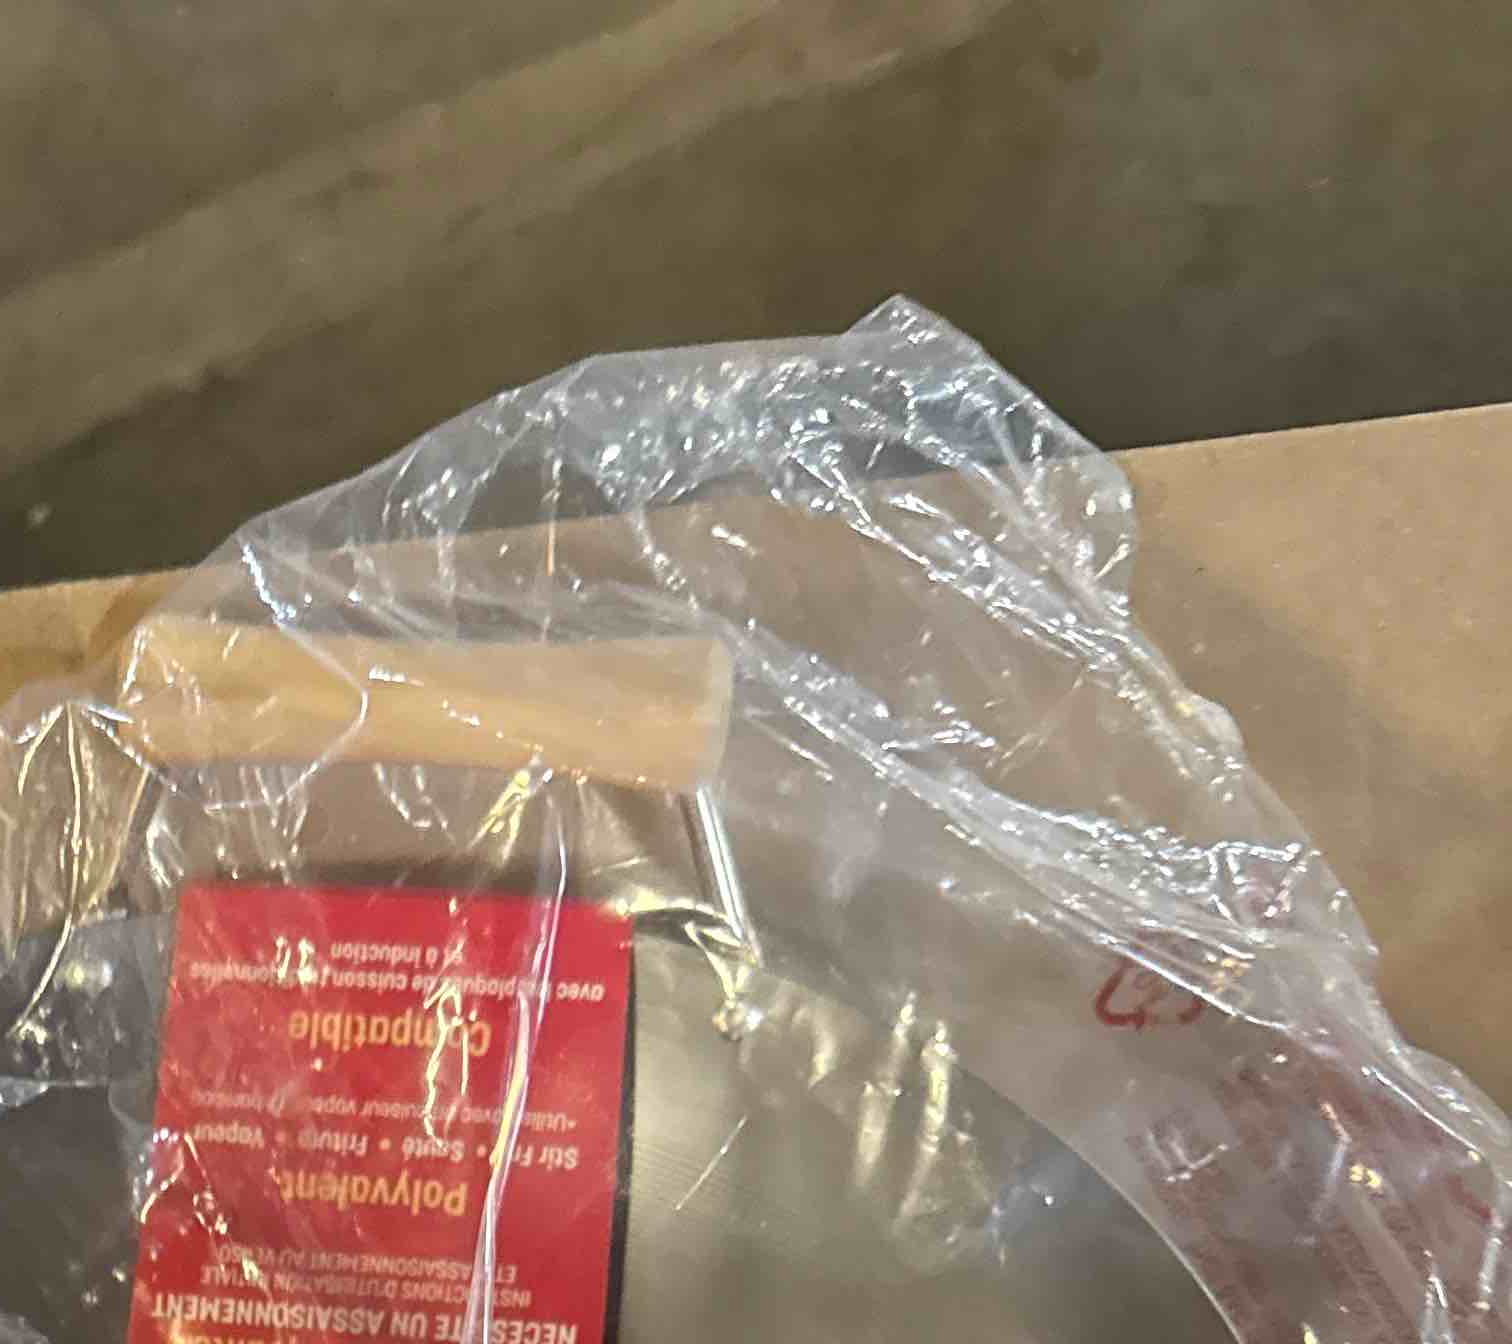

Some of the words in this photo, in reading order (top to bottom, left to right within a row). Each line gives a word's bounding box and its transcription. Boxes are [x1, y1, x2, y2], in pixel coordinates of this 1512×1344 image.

[330, 942, 421, 968] induction
[330, 969, 408, 993] cuisson
[439, 972, 517, 1000] plaqus
[556, 982, 605, 1002] avec
[286, 1010, 493, 1058] Compatible
[537, 1145, 580, 1171] Stir
[280, 1168, 469, 1218] Polyvalent
[215, 1242, 275, 1266] VESO
[402, 1281, 532, 1309] INSTCTIONS
[151, 1291, 384, 1335] ASSAISONNEMENT
[390, 1311, 428, 1340] UN
